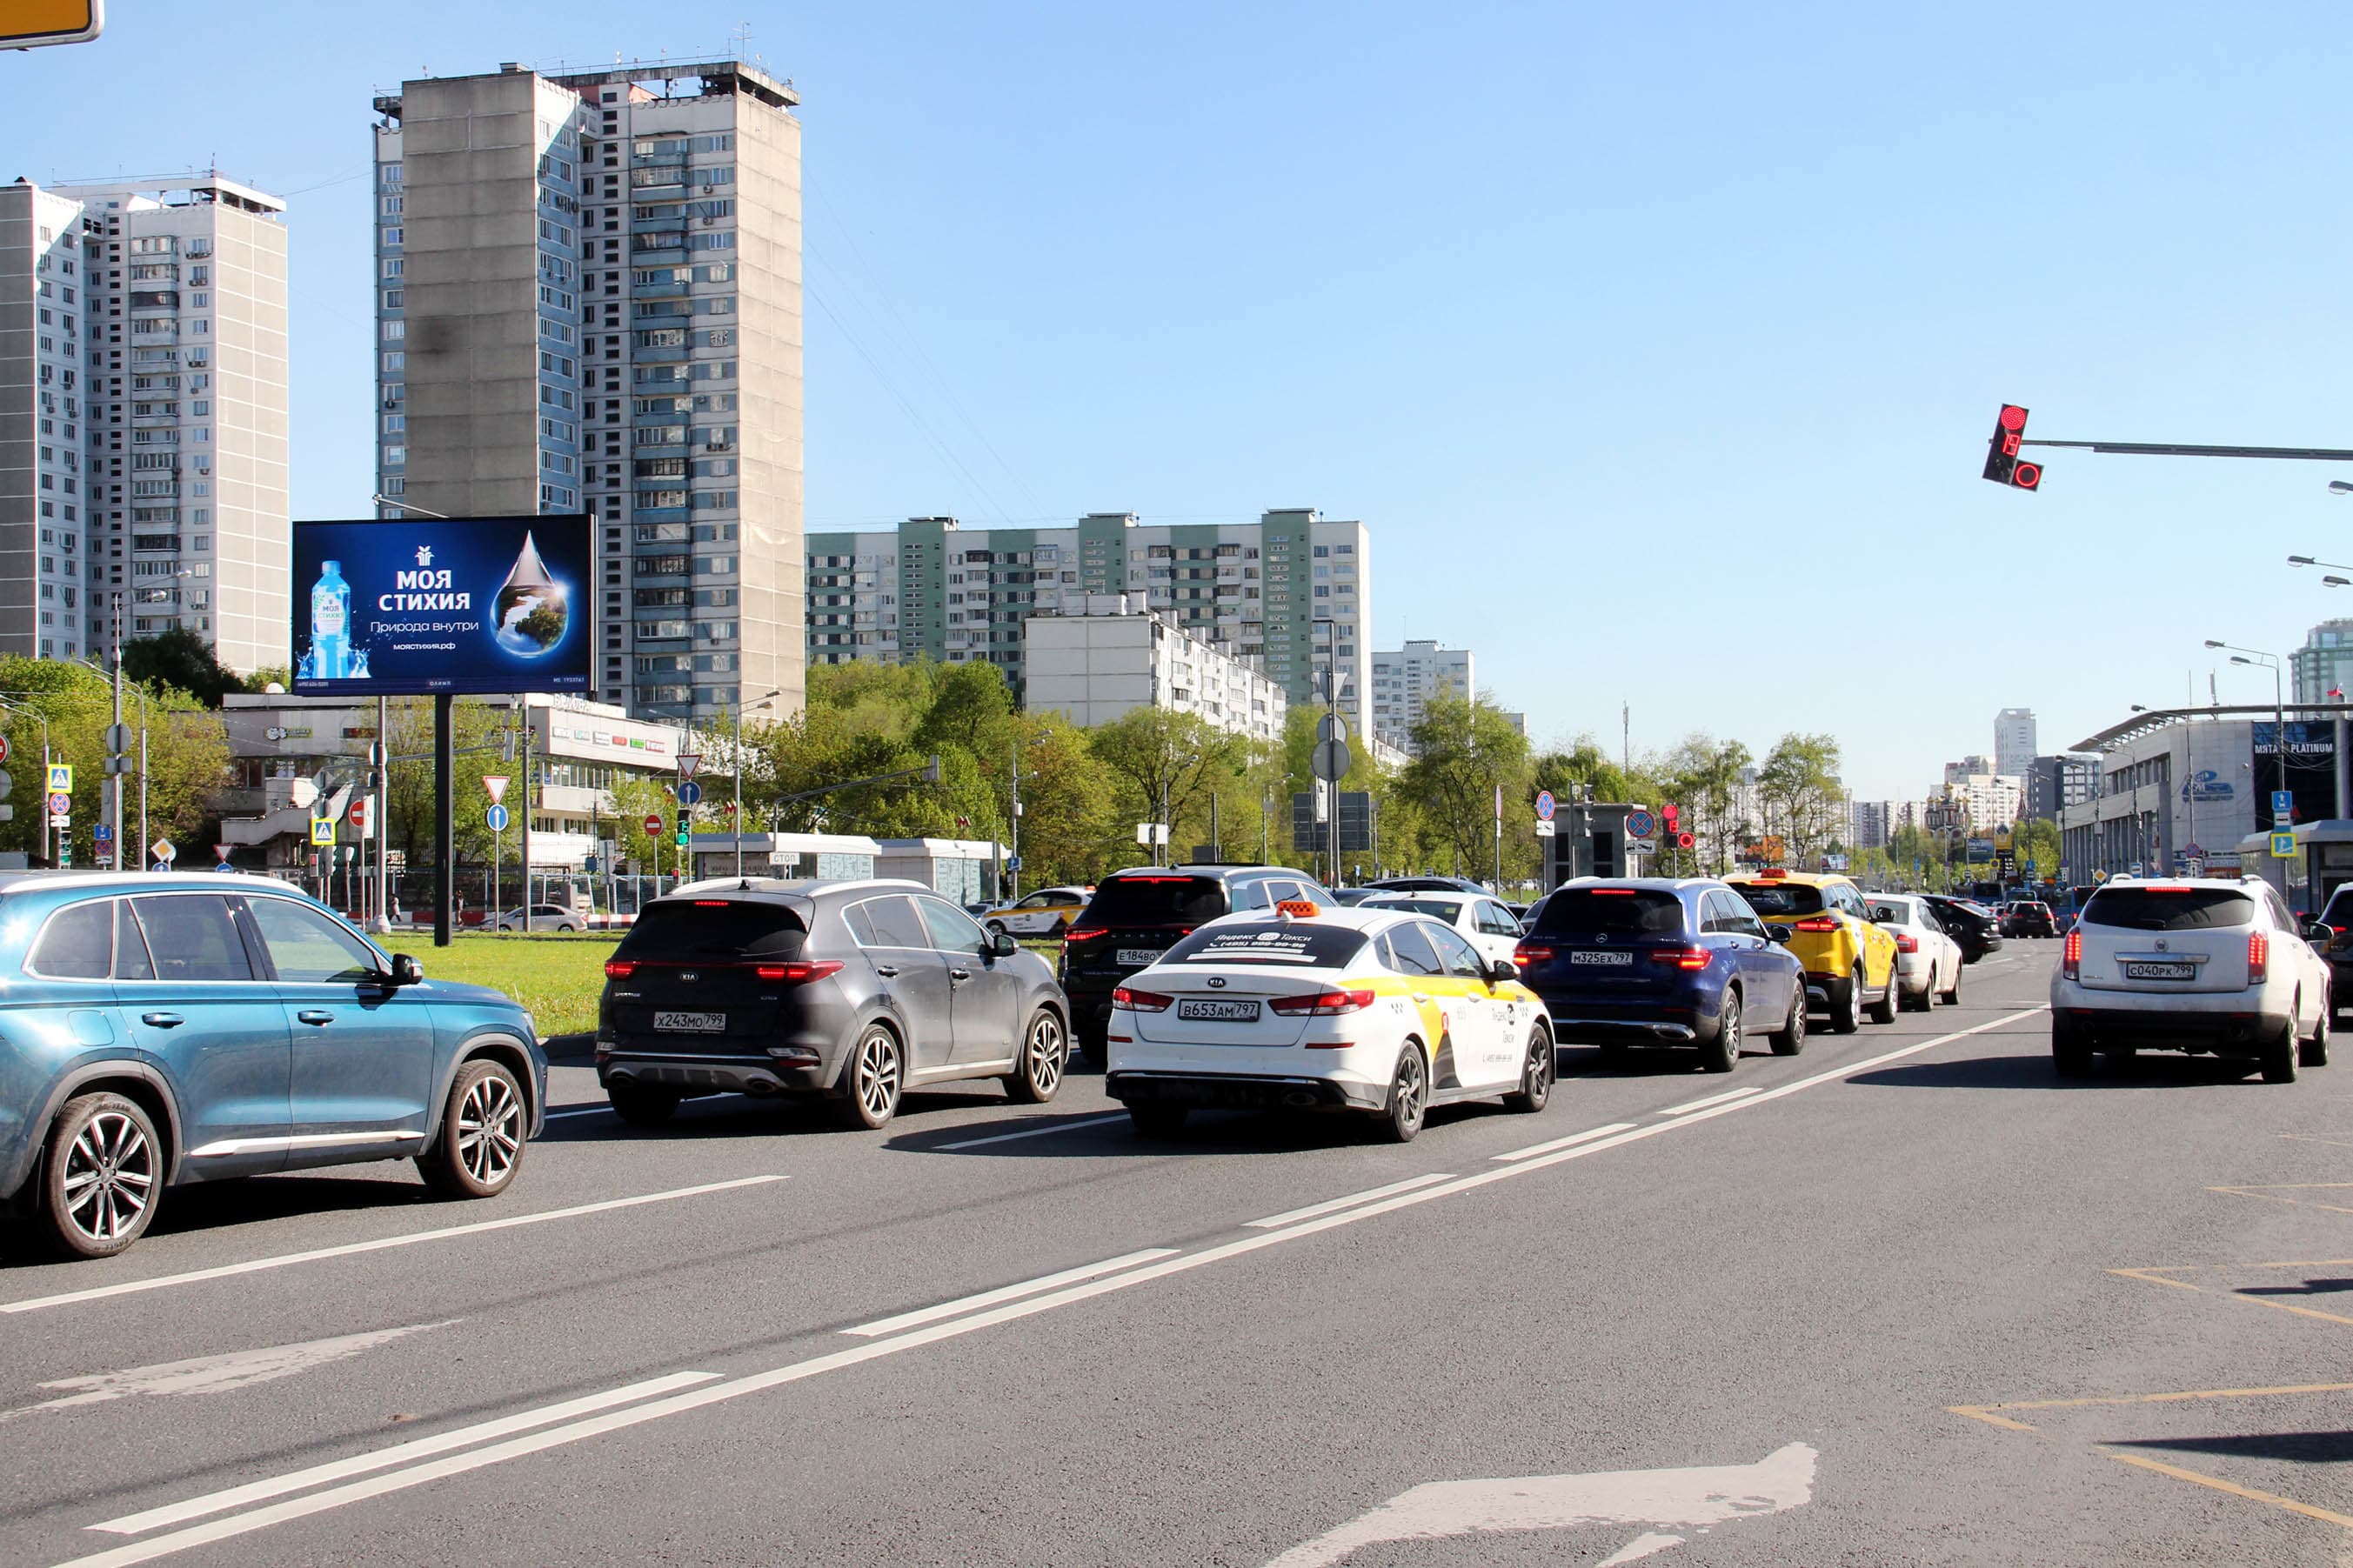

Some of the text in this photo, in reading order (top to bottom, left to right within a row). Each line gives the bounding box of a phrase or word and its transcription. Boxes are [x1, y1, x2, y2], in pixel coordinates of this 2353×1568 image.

[2002, 434, 2020, 456] 19
[397, 570, 451, 590] МОЯ
[378, 593, 471, 611] СТИХИЯ
[371, 622, 479, 633] Природа внутри
[2255, 743, 2333, 754] МЯТА PLATINUM
[774, 854, 796, 863] СТОП
